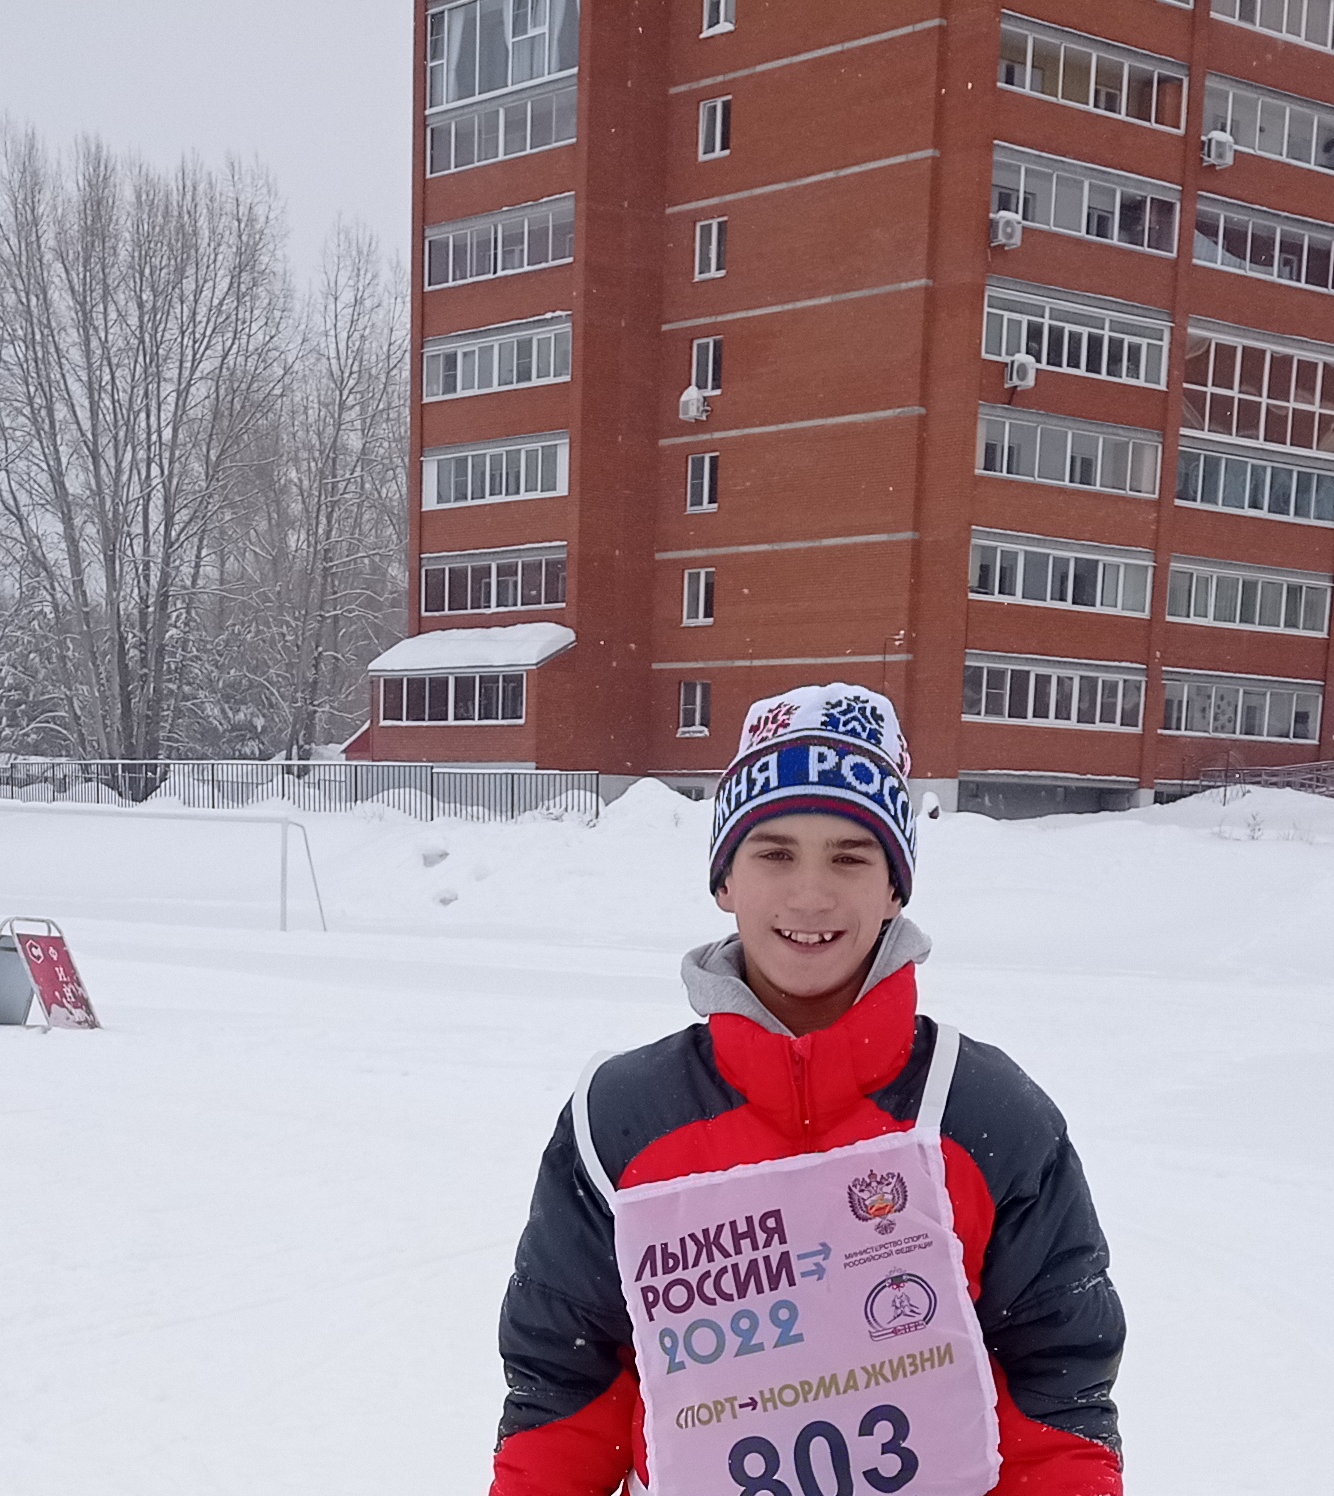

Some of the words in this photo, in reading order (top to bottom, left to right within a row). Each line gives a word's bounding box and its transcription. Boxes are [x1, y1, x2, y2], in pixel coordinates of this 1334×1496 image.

[634, 1209, 788, 1282] ЛЫЖНЯ
[843, 1250, 894, 1269] РОССИЙСКОЙ
[894, 1241, 933, 1255] ФЕДЕРАЦИИ
[844, 1239, 903, 1260] МИНИСТЕРСТВО
[903, 1233, 929, 1244] СПОРТА
[640, 1250, 797, 1322] РОССИИ
[658, 1299, 805, 1375] 2022
[758, 1369, 859, 1412] НОРМА
[860, 1342, 955, 1390] ЖИЗНИ
